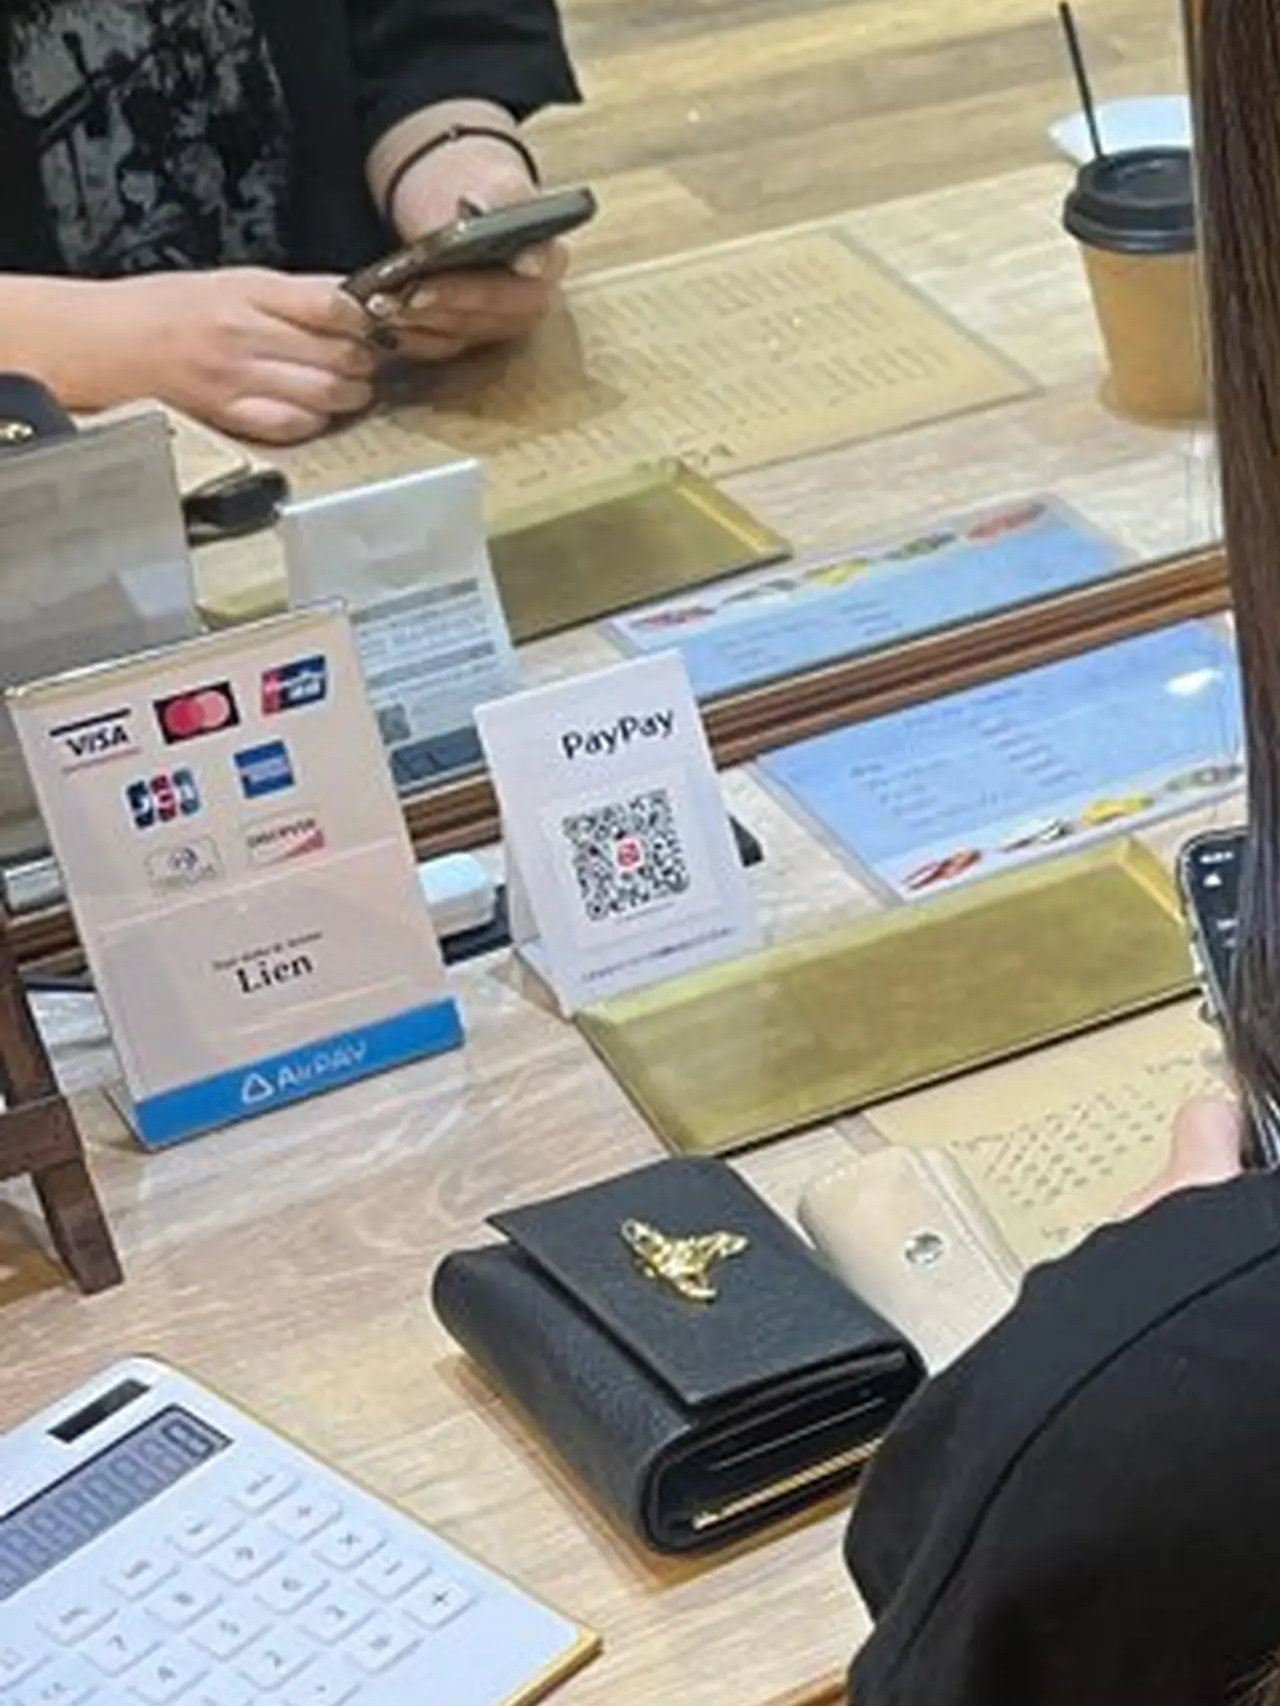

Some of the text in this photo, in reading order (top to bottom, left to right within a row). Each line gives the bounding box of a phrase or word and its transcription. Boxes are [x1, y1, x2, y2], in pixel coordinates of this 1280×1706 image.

[65, 725, 130, 757] VISA
[561, 710, 675, 759] PayPay
[235, 953, 314, 993] Lien
